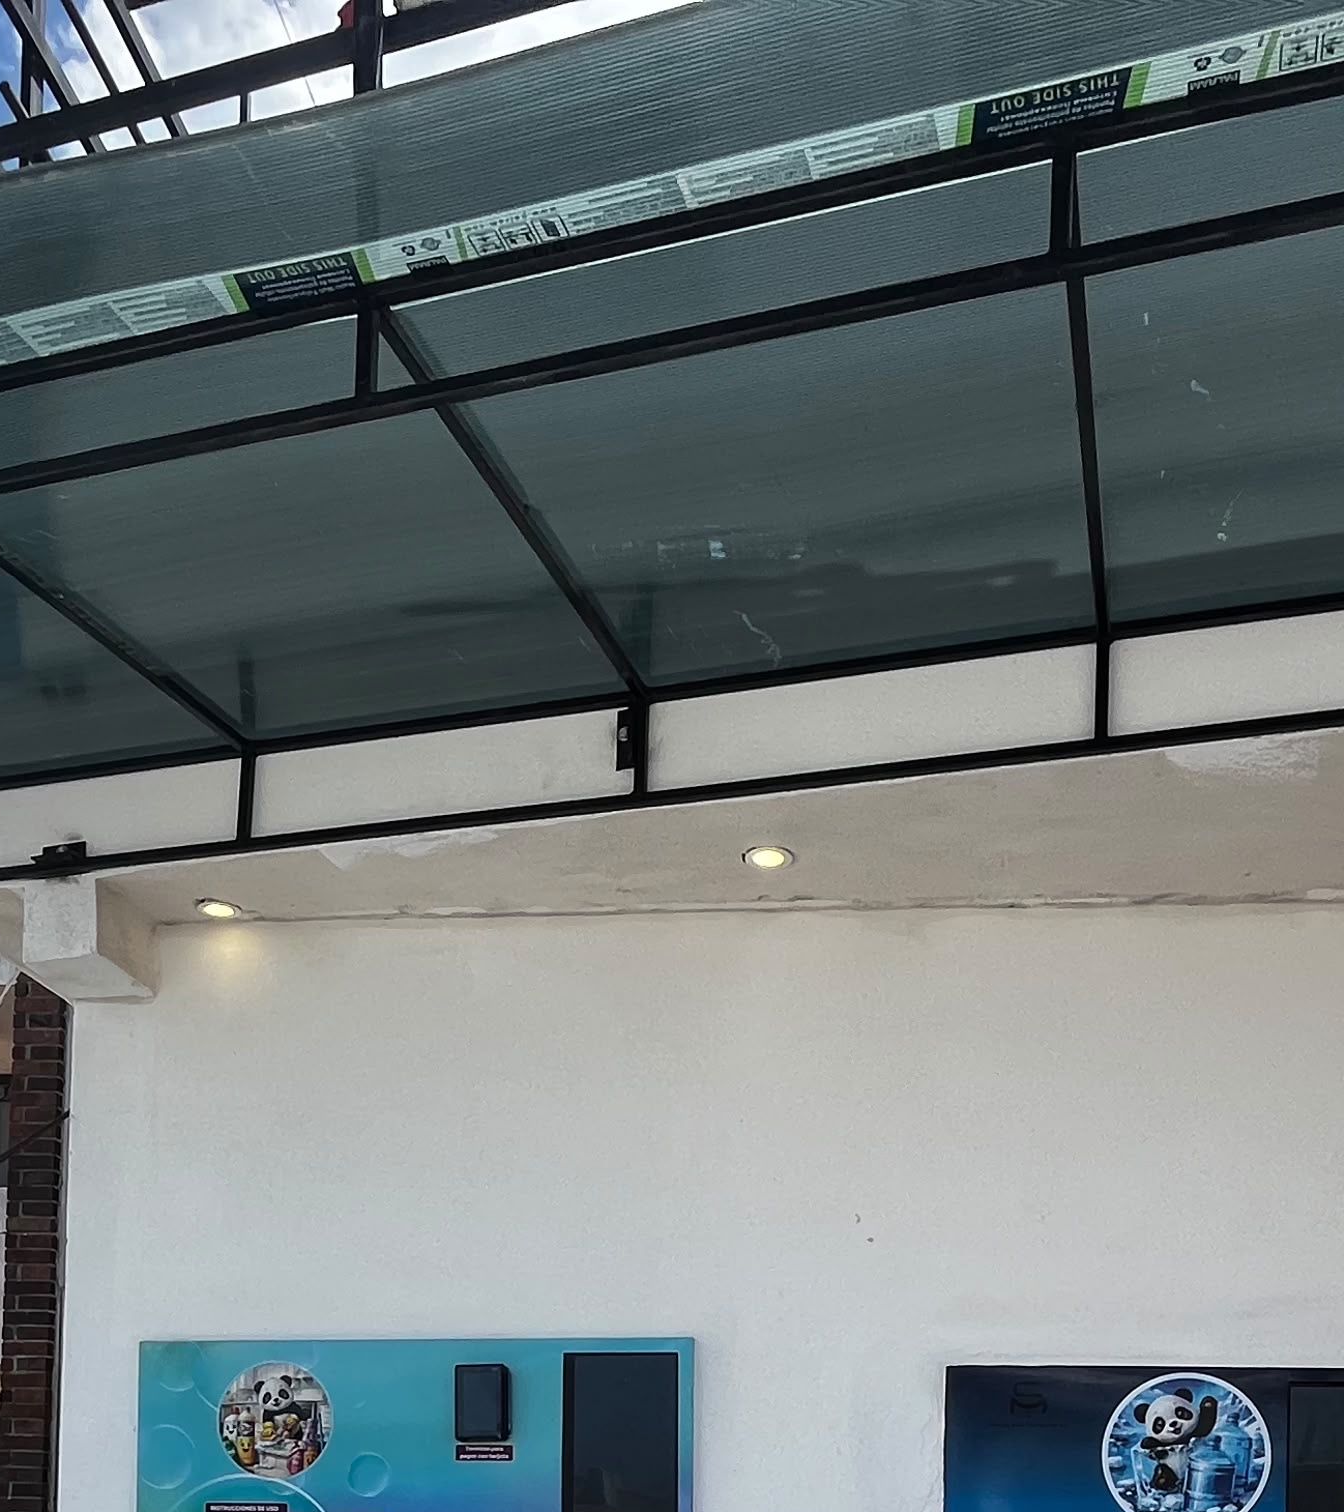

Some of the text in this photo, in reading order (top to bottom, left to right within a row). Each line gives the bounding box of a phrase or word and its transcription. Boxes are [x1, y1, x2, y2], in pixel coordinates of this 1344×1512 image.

[990, 73, 1120, 115] THIS SIDE OUT
[247, 257, 348, 283] THIS SIDE OUT
